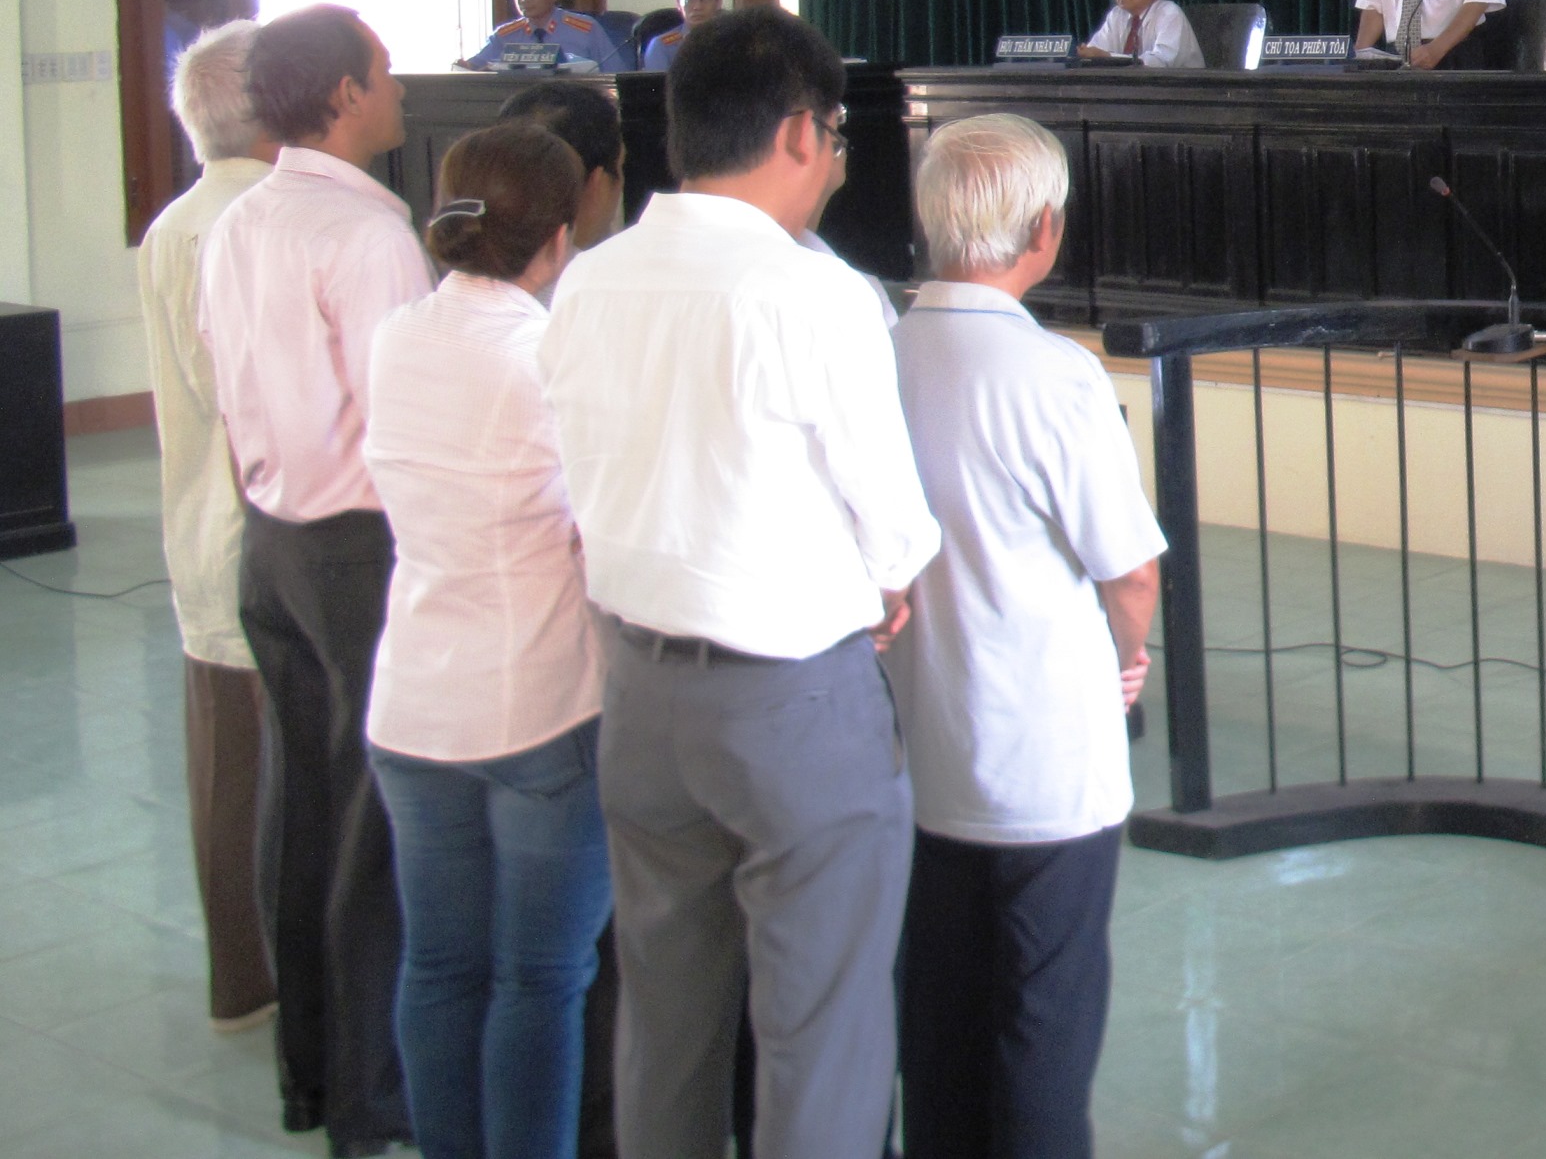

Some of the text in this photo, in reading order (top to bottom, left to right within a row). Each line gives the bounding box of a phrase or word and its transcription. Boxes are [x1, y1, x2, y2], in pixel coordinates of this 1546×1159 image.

[1265, 38, 1345, 56] CHỦ TỌA PHIÊN TÒA
